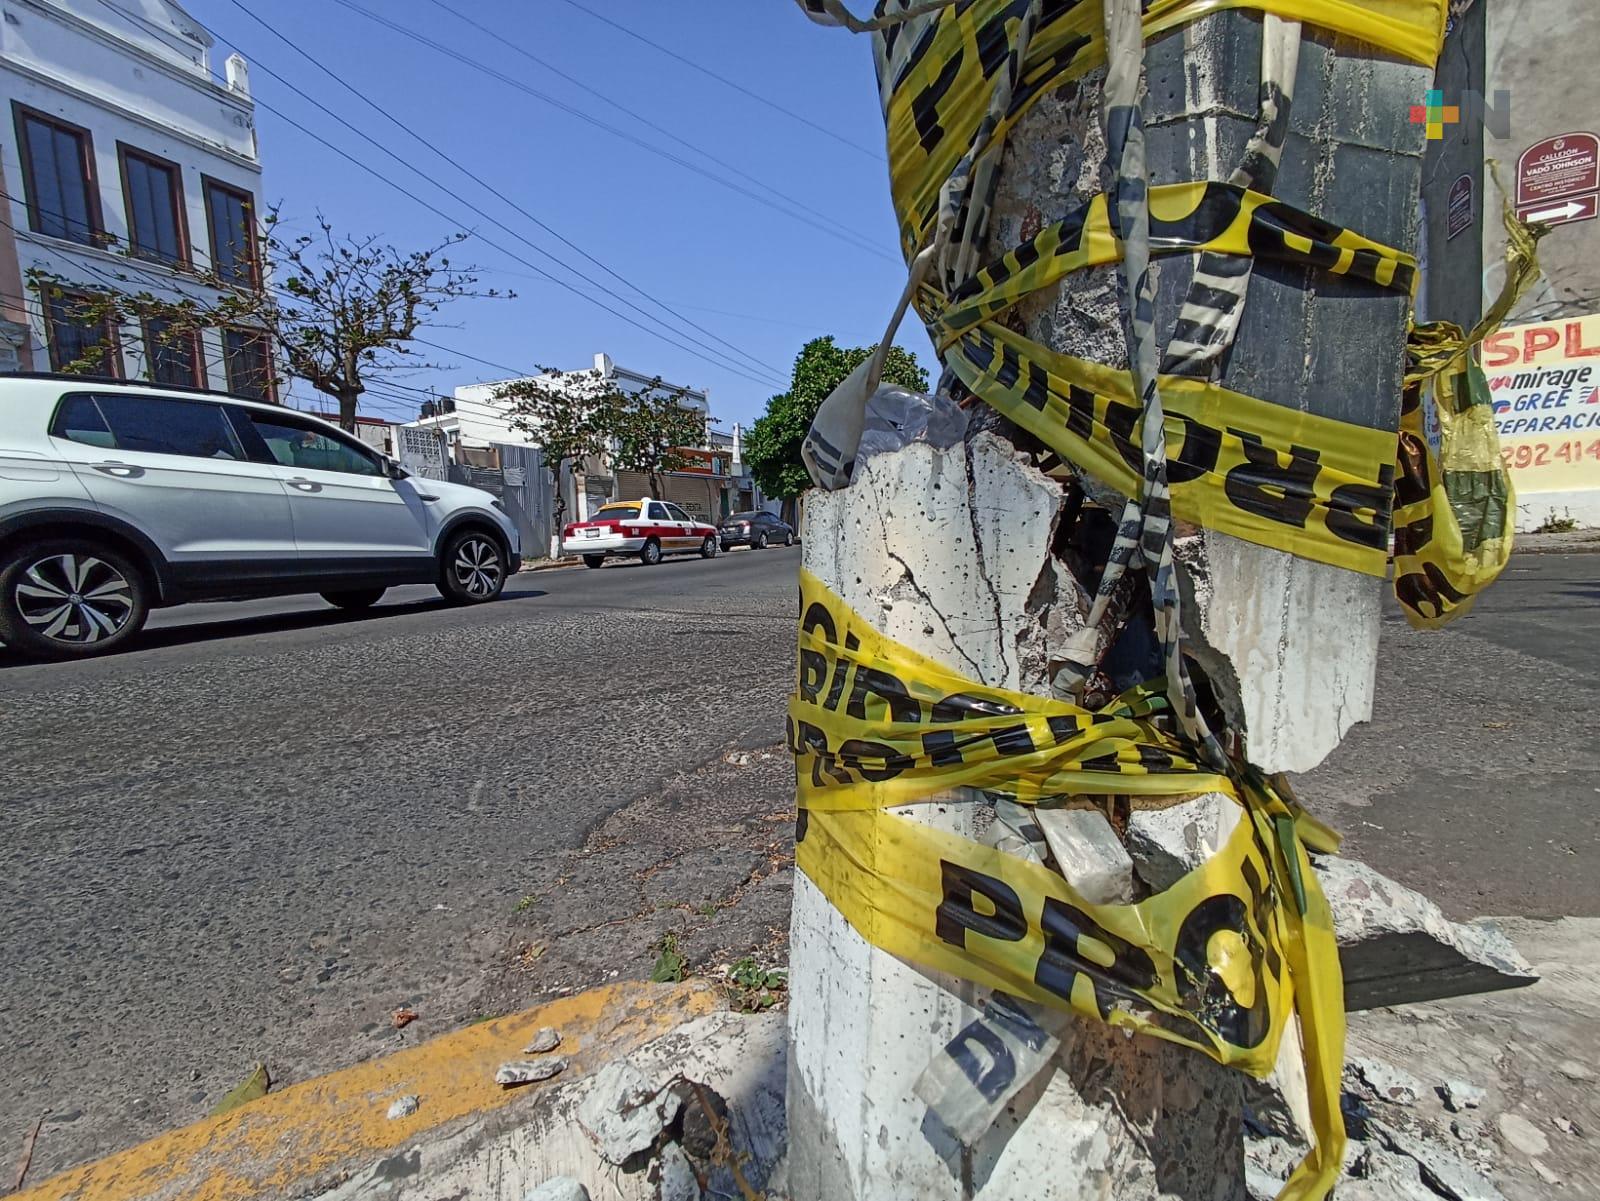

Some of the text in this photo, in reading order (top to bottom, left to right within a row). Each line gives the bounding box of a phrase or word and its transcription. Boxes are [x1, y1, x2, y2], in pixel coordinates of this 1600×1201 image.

[1526, 165, 1550, 177] VADO
[1551, 156, 1593, 172] JOHNSON
[1511, 366, 1593, 390] mirage
[1513, 389, 1573, 412] GREE
